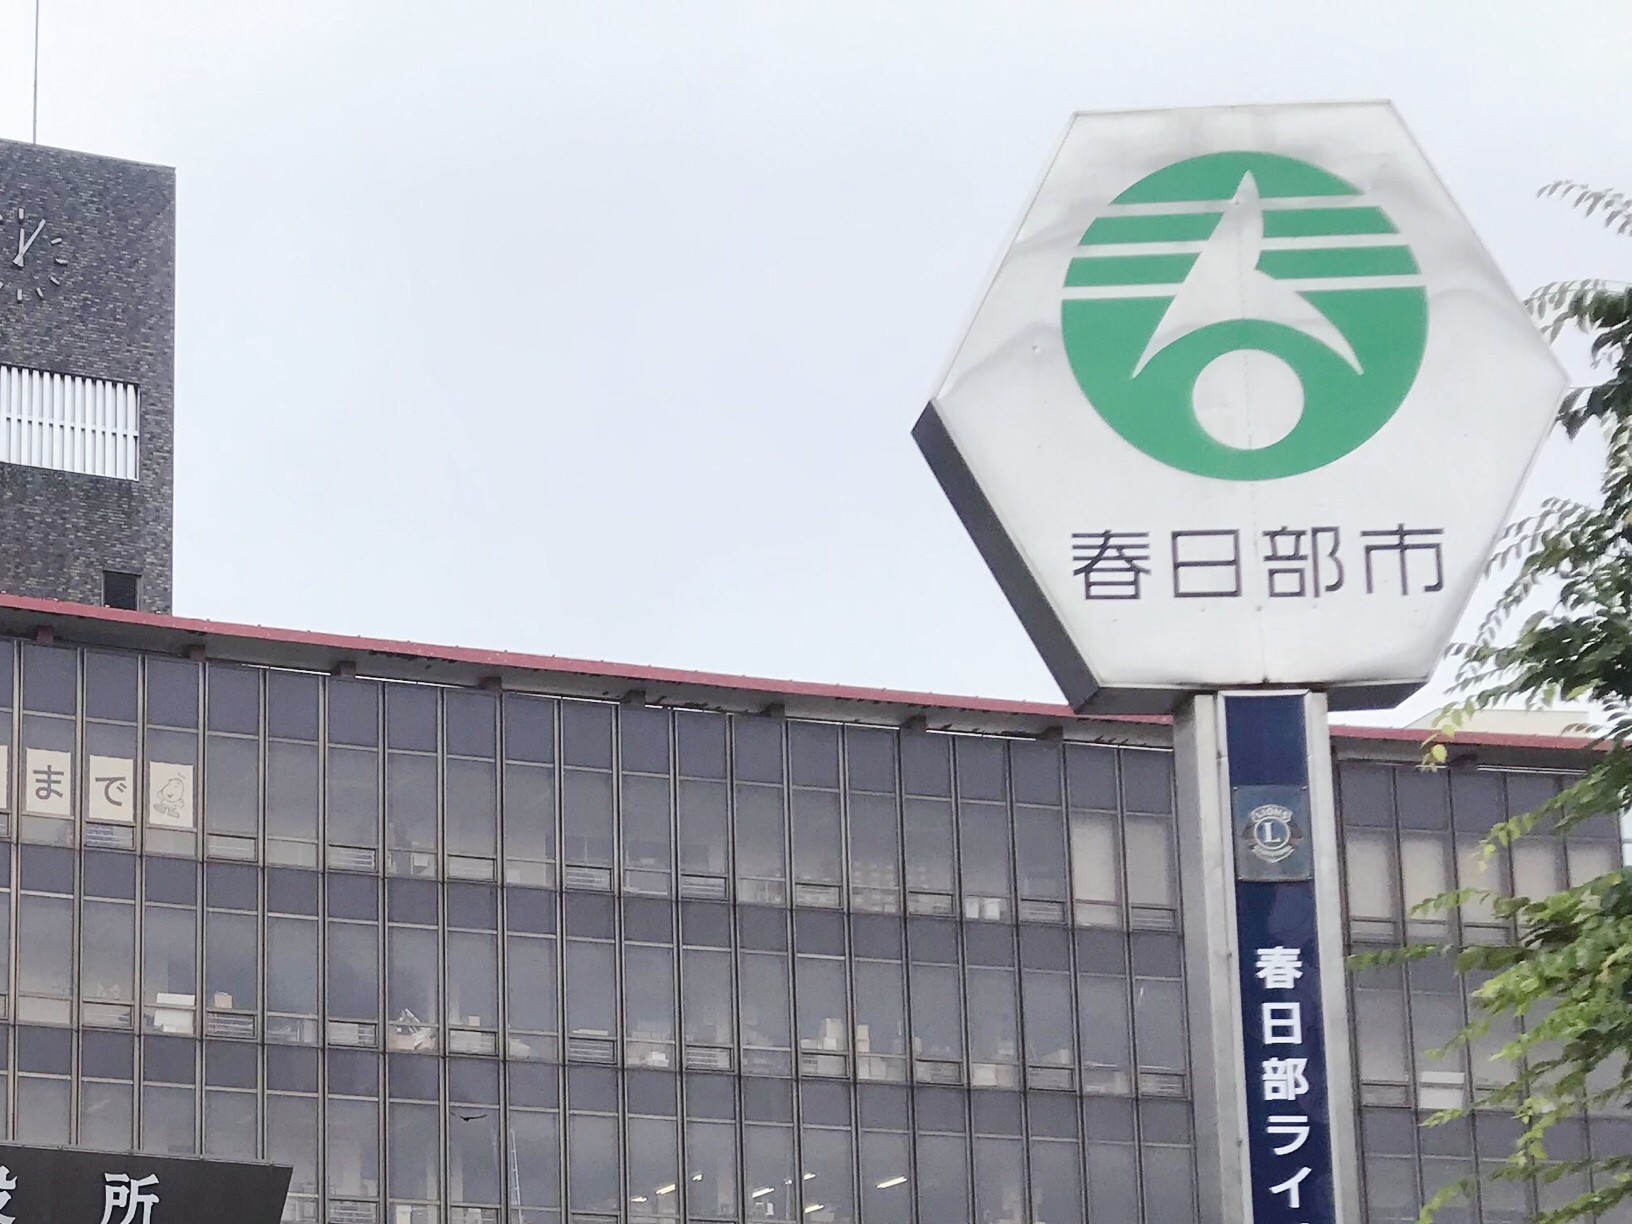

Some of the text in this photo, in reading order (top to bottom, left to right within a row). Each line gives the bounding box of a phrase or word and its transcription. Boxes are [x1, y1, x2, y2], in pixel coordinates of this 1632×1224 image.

[1071, 523, 1445, 600] 春日部市
[1263, 822, 1281, 843] L
